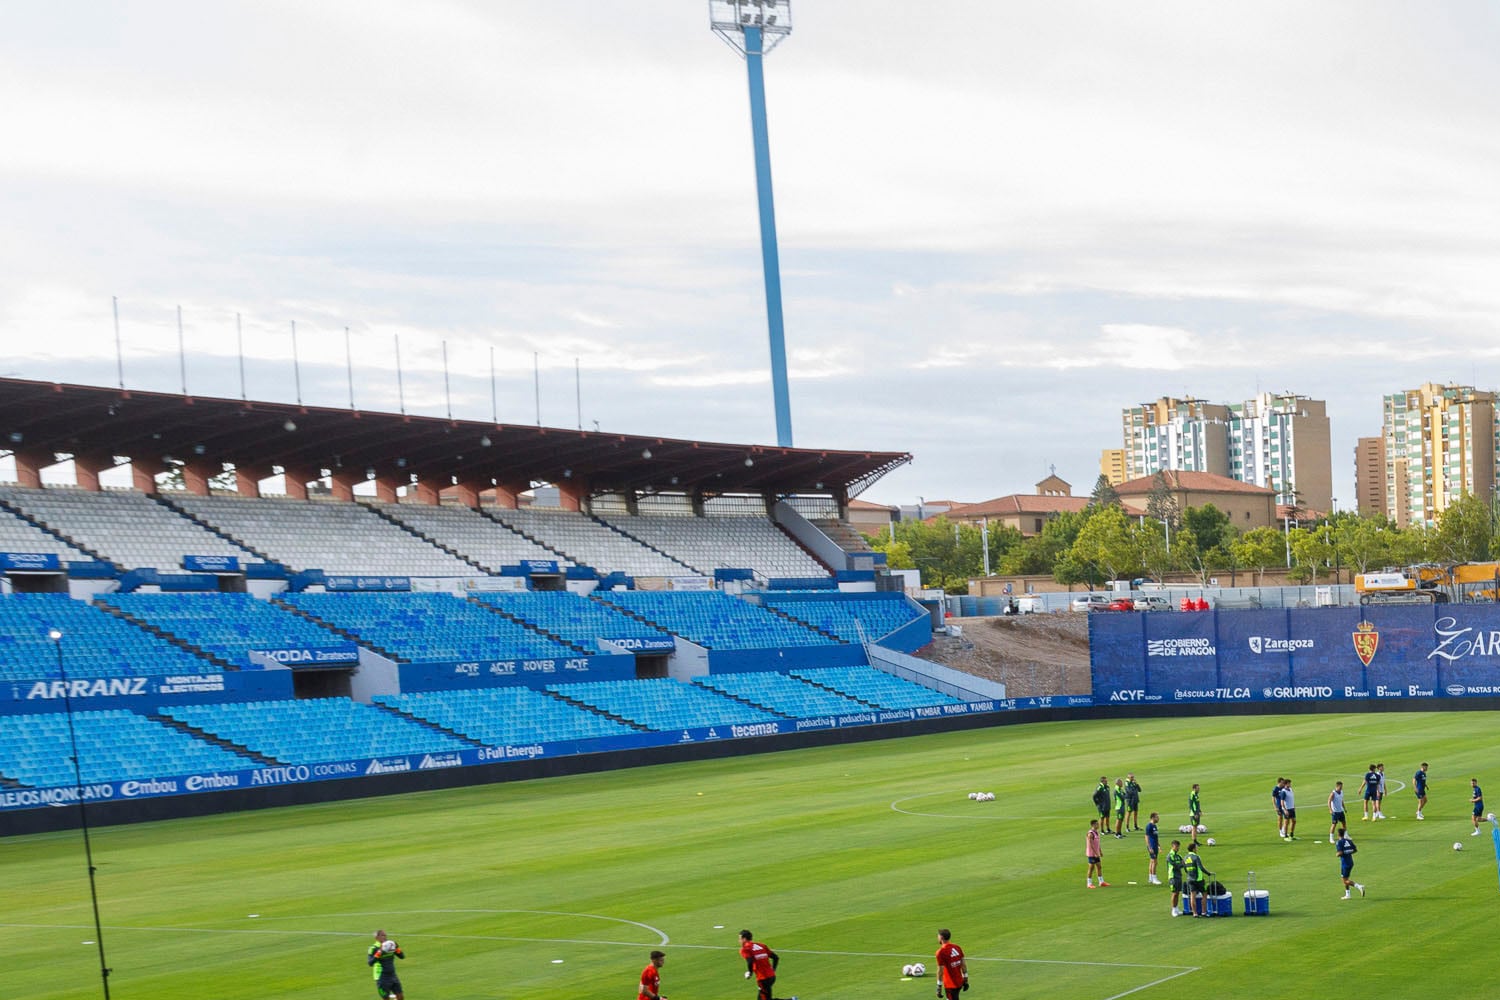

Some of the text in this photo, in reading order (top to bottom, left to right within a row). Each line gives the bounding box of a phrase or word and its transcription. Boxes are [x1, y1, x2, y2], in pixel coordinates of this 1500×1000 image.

[1164, 638, 1209, 648] GOBIERNO
[1264, 638, 1314, 651] Zaragoza
[1164, 647, 1177, 656] DE
[27, 678, 148, 699] ARRANZ
[1215, 688, 1251, 699] TILCA
[1273, 686, 1333, 698] GRUPAUTO
[731, 722, 779, 737] tecemac
[486, 747, 505, 759] Full
[250, 766, 310, 785] ARTICO
[314, 763, 357, 776] COCINAS
[120, 778, 178, 797] embou
[185, 772, 239, 791] embou
